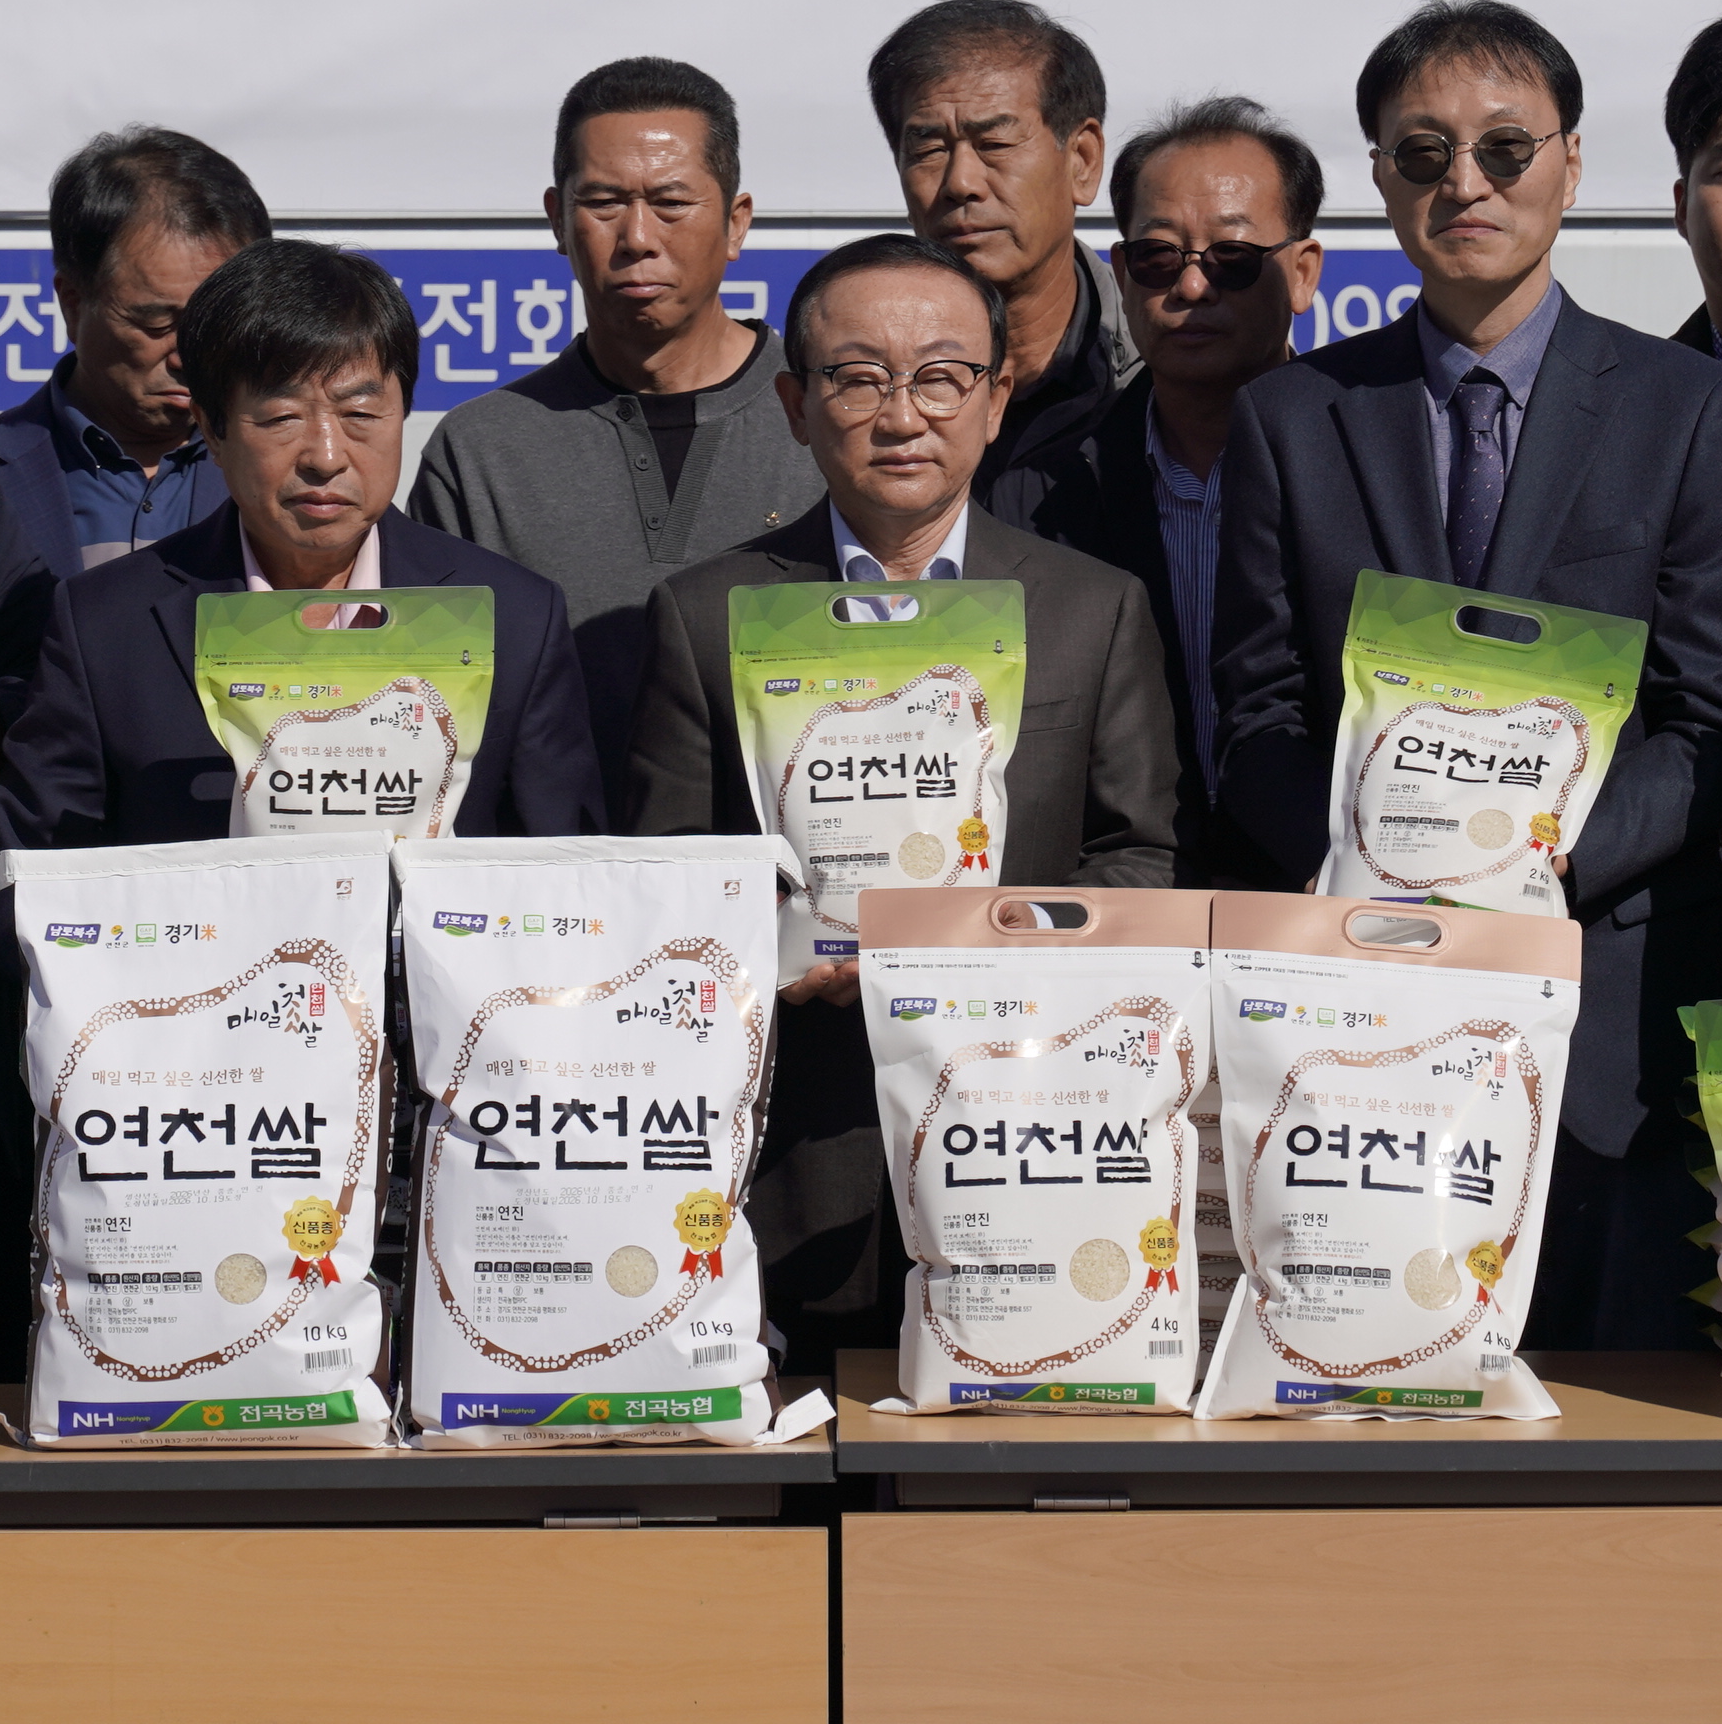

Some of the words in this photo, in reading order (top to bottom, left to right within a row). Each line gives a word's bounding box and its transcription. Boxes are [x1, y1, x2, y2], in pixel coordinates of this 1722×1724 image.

[1394, 735, 1550, 790] 연천쌀
[808, 753, 958, 804] 연천쌀
[269, 769, 422, 816] 연천쌀
[1529, 868, 1537, 879] 2
[1539, 871, 1550, 884] kg
[437, 912, 485, 928] 남토북수
[552, 916, 605, 936] 경기米
[49, 925, 97, 939] 남토북수
[164, 923, 217, 944] 경기米
[993, 999, 1039, 1018] 경기米
[1342, 1010, 1388, 1028] 경기米
[92, 1070, 121, 1085] 매일
[129, 1070, 157, 1085] 먹고
[164, 1070, 193, 1086] 싶은
[199, 1069, 243, 1086] 신선한
[249, 1068, 264, 1084] 쌀
[958, 1090, 983, 1104] 매일
[988, 1089, 1014, 1104] 먹고
[1051, 1089, 1090, 1105] 신선한
[1096, 1088, 1110, 1103] 쌀
[469, 1094, 719, 1171] 연천쌀
[75, 1102, 326, 1182] 연천쌀
[943, 1118, 1151, 1188] 연천쌀
[1286, 1124, 1501, 1206] 연천쌀
[498, 1205, 524, 1221] 연진
[684, 1213, 723, 1227] 신품종
[965, 1212, 990, 1228] 연진
[1302, 1212, 1328, 1228] 연진
[105, 1217, 132, 1232] 연진
[293, 1220, 334, 1235] 신품종
[1146, 1236, 1175, 1249] 신품종
[303, 1325, 321, 1342] 10
[327, 1325, 347, 1341] kg
[690, 1321, 708, 1338] 10
[713, 1320, 733, 1336] kg
[1151, 1317, 1160, 1332] 4
[1164, 1316, 1178, 1334] kg
[1483, 1331, 1493, 1346] 4
[1497, 1333, 1512, 1350] kg
[961, 1390, 991, 1401] NH
[1075, 1387, 1138, 1401] 전곡농협
[1287, 1388, 1317, 1400] NH
[1402, 1392, 1465, 1405] 전곡농협
[239, 1402, 327, 1423] 전곡농협
[457, 1403, 498, 1418] NH
[625, 1397, 712, 1417] 전곡농협
[73, 1412, 114, 1428] NH
